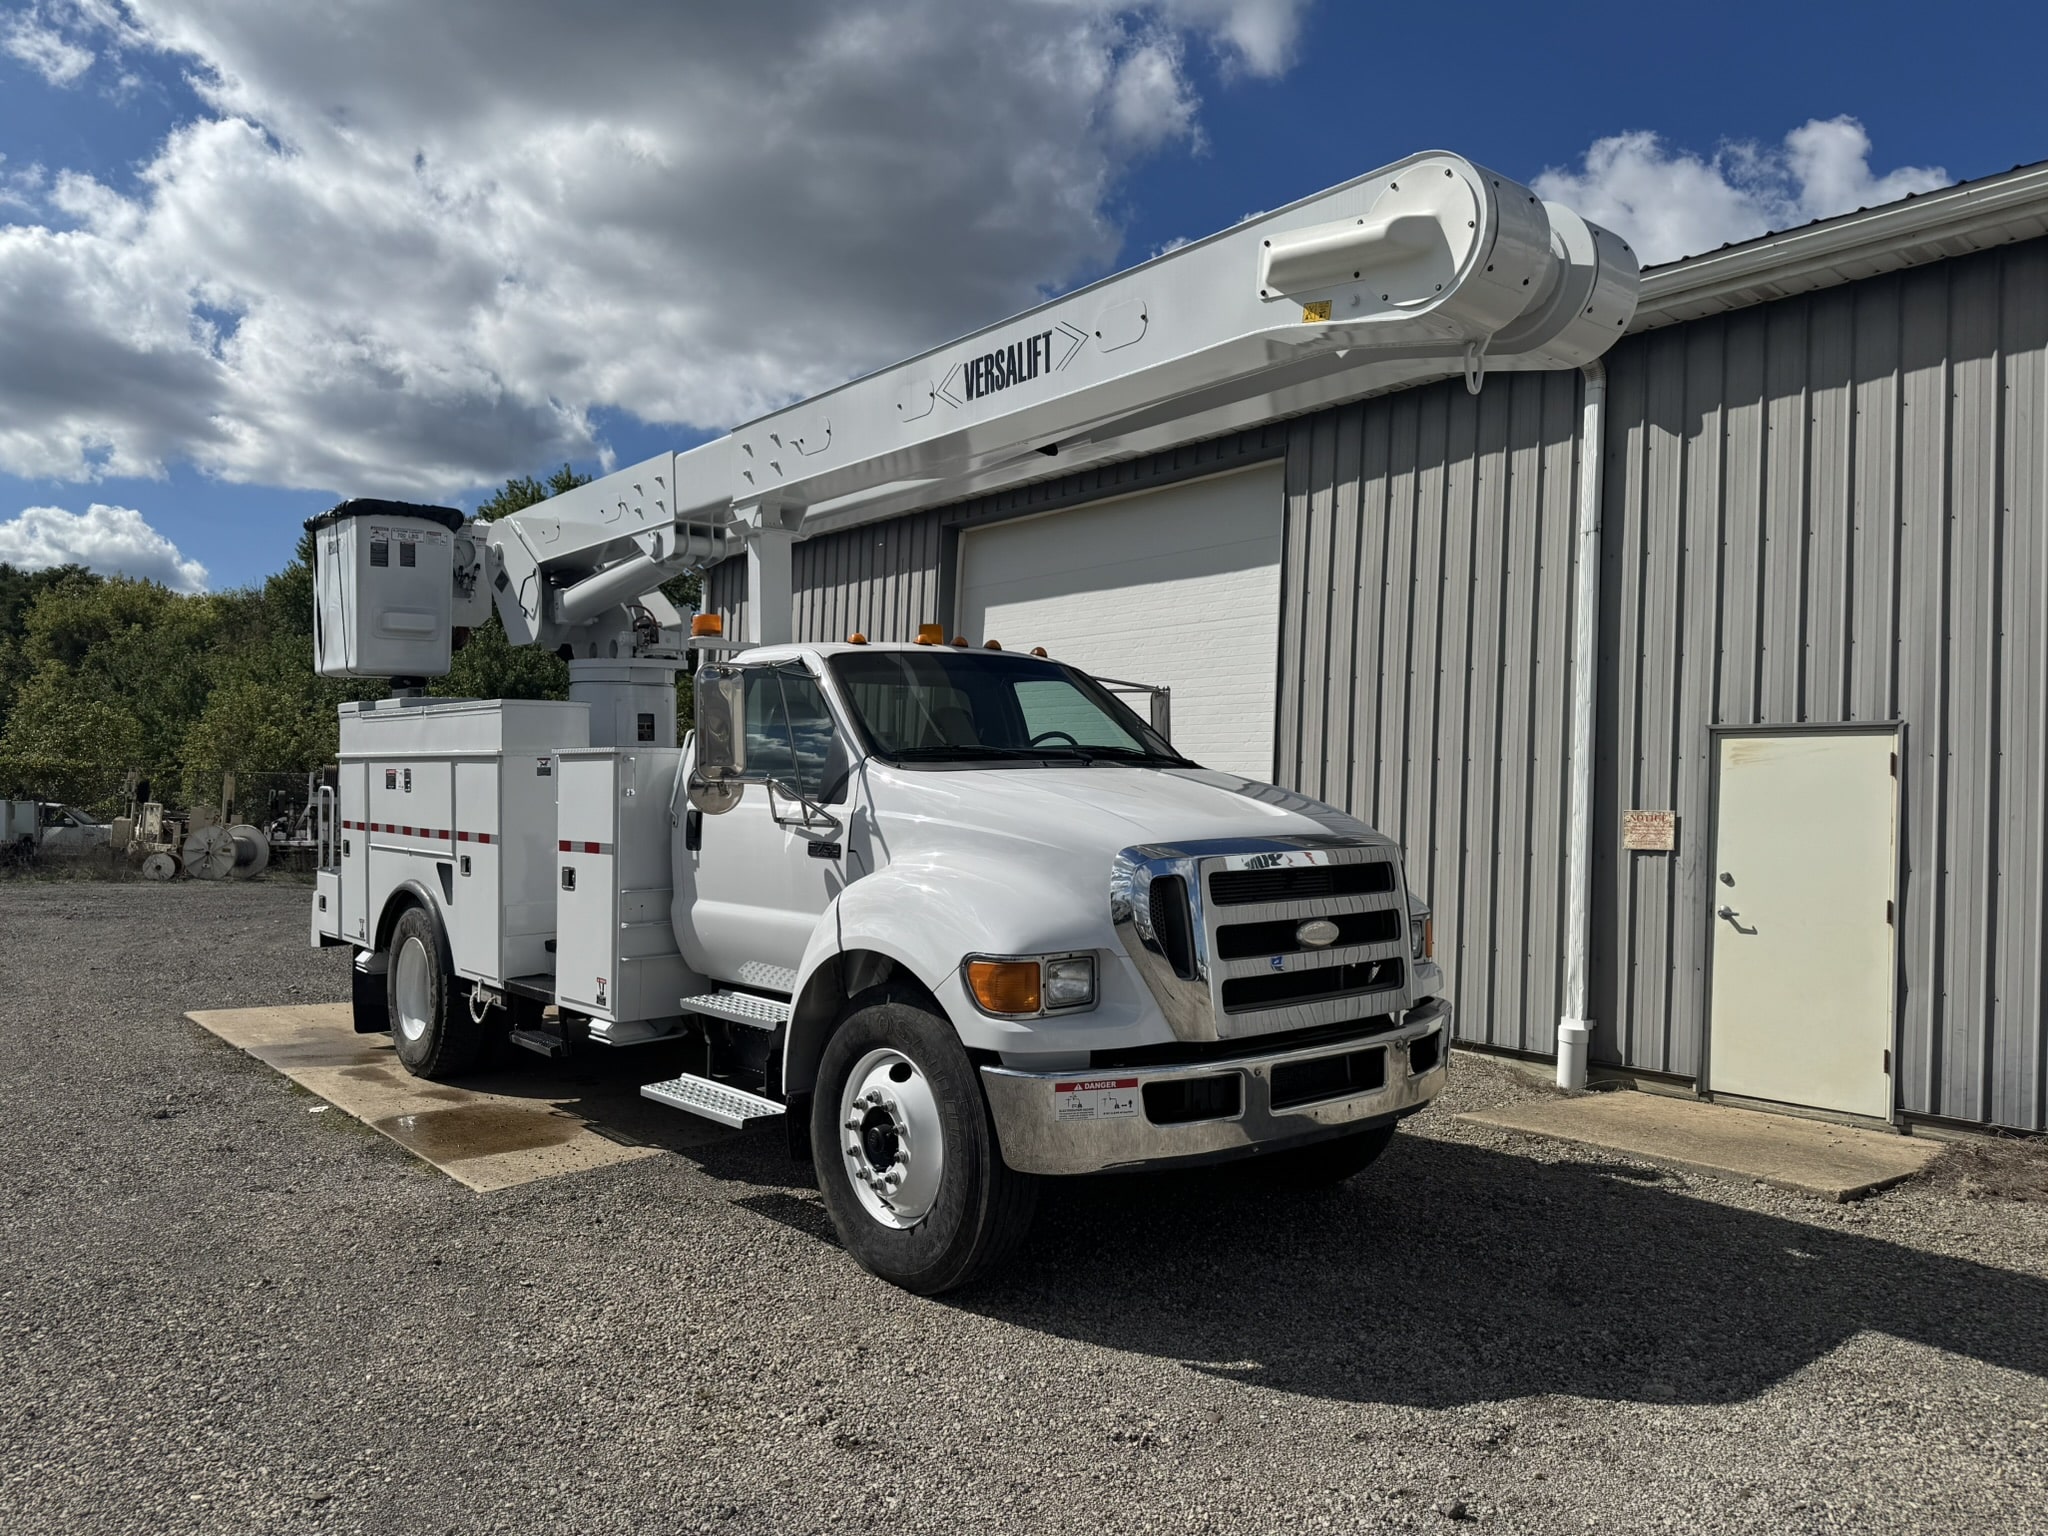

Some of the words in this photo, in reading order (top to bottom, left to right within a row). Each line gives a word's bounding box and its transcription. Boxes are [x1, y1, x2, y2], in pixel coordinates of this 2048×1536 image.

[964, 329, 1053, 402] VERSALIFT
[1631, 814, 1667, 823] NOTICE
[1084, 1081, 1117, 1090] DANGER
